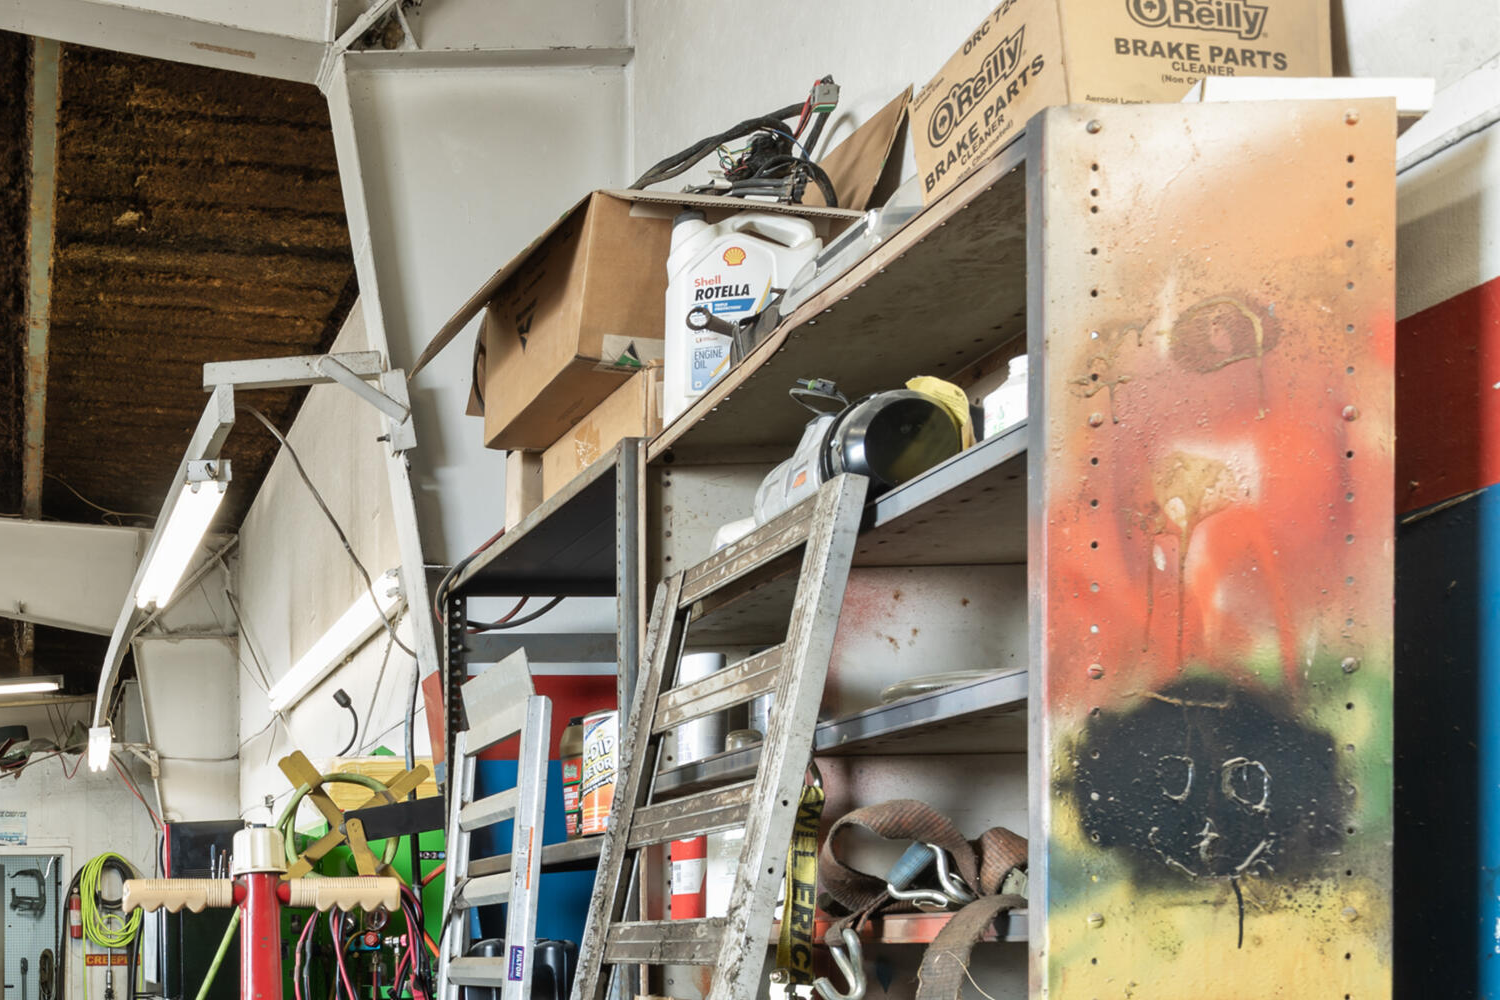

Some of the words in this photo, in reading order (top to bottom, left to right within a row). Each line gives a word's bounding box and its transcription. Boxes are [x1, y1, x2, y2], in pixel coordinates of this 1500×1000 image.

[962, 20, 991, 56] ORC
[1114, 37, 1201, 61] BRAKE
[1208, 45, 1288, 71] PARTS
[1171, 61, 1235, 77] CLEANER
[930, 26, 1025, 146] O'Reilly
[925, 122, 978, 194] BRAKE
[984, 54, 1045, 128] PARTS
[961, 114, 1005, 166] CLEANER
[694, 274, 721, 287] Shell
[695, 284, 750, 301] ROTELLA
[694, 349, 723, 361] ENGINE
[694, 360, 707, 369] OIL
[86, 955, 128, 965] CREEP
